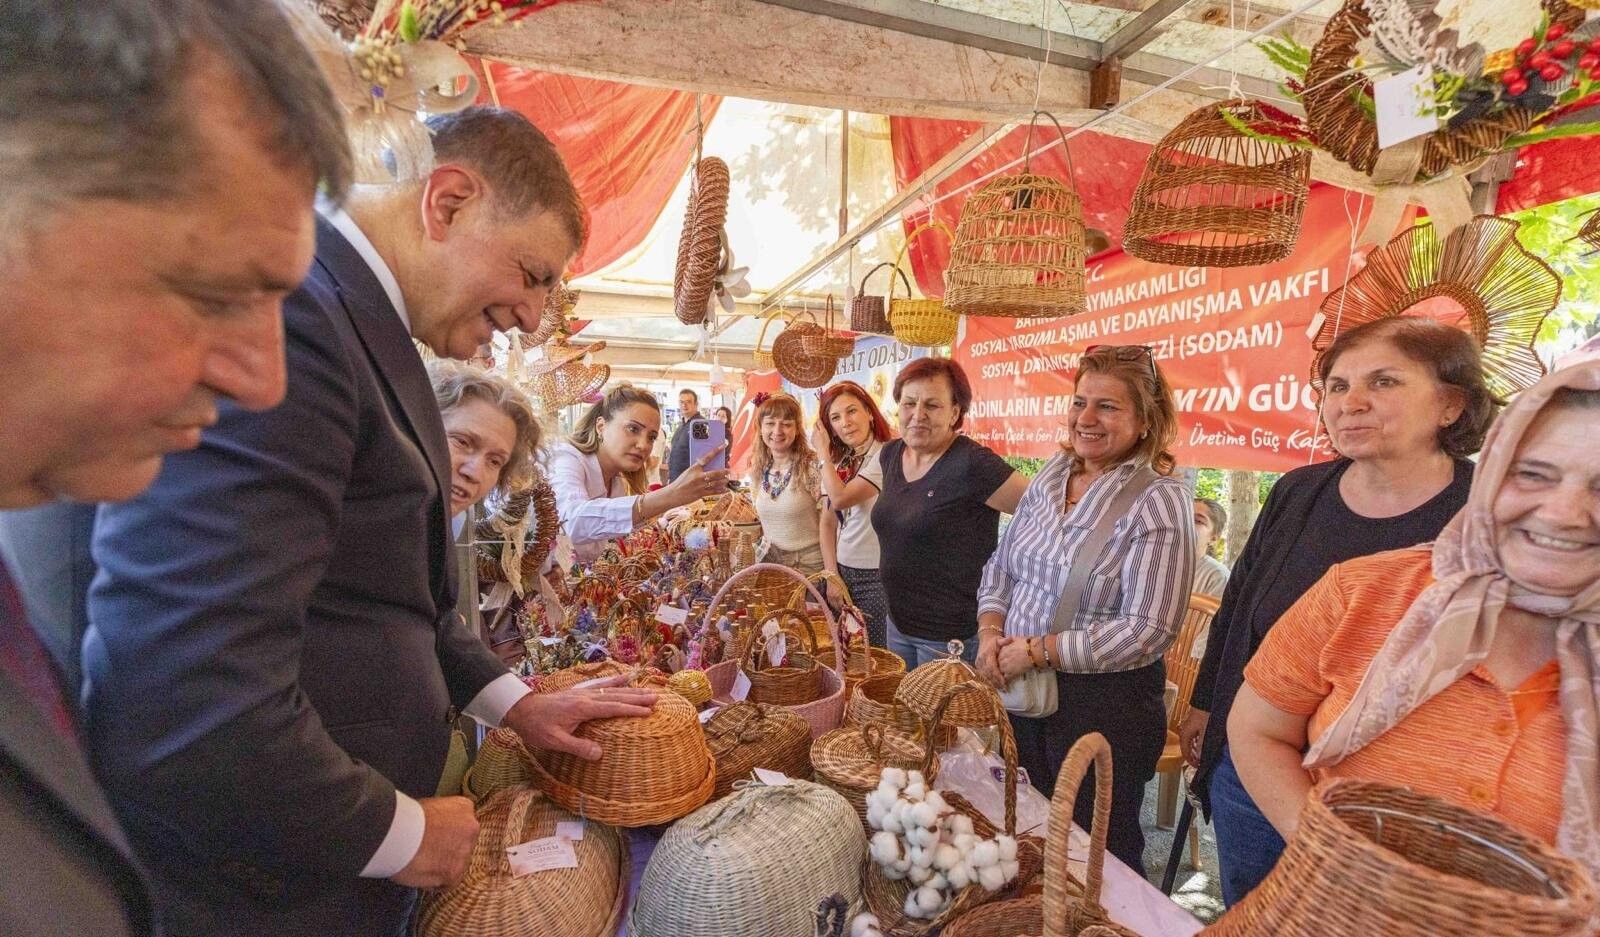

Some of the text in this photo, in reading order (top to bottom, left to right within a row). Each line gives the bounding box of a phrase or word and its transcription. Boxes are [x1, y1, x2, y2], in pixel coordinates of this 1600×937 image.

[970, 267, 1329, 358] SOSYAL YARDIMLAŞMA VE DAYANIŞMA VAKFI
[868, 342, 914, 369] ODASI
[982, 361, 1020, 379] SOSYAL
[1023, 352, 1085, 374] DAYANIŞM
[1179, 320, 1283, 359] (SODAM)
[966, 396, 1040, 418] ADINLARIN
[1189, 421, 1246, 446] Üretime
[1251, 427, 1280, 453] Güç
